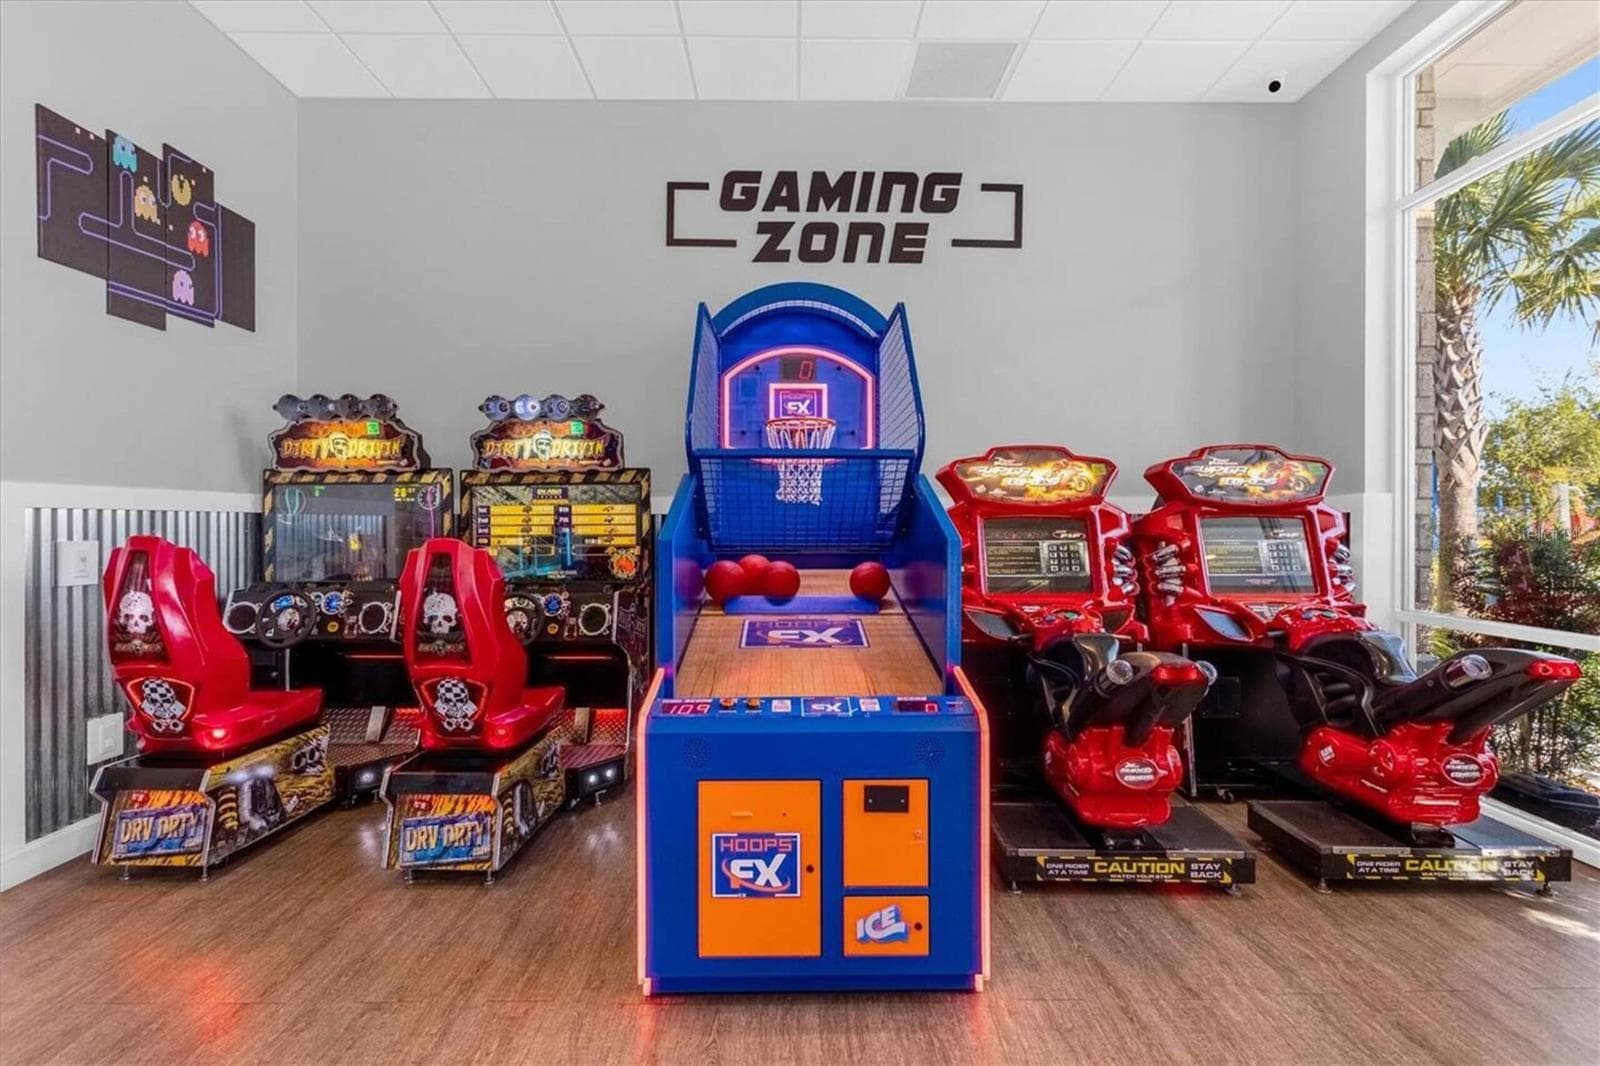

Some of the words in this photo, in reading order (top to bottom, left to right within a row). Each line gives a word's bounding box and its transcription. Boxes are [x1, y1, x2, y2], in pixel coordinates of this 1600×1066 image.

[719, 170, 963, 213] GAMING
[751, 221, 929, 264] ZONE
[799, 360, 813, 380] 0
[767, 627, 844, 645] FX
[720, 838, 792, 852] HOOPS
[730, 853, 787, 889] FX
[1093, 862, 1185, 874] CAUTION
[1190, 863, 1221, 871] STAY
[1190, 871, 1222, 879] BACK
[1503, 869, 1536, 877] BACK
[856, 904, 907, 942] ICE
